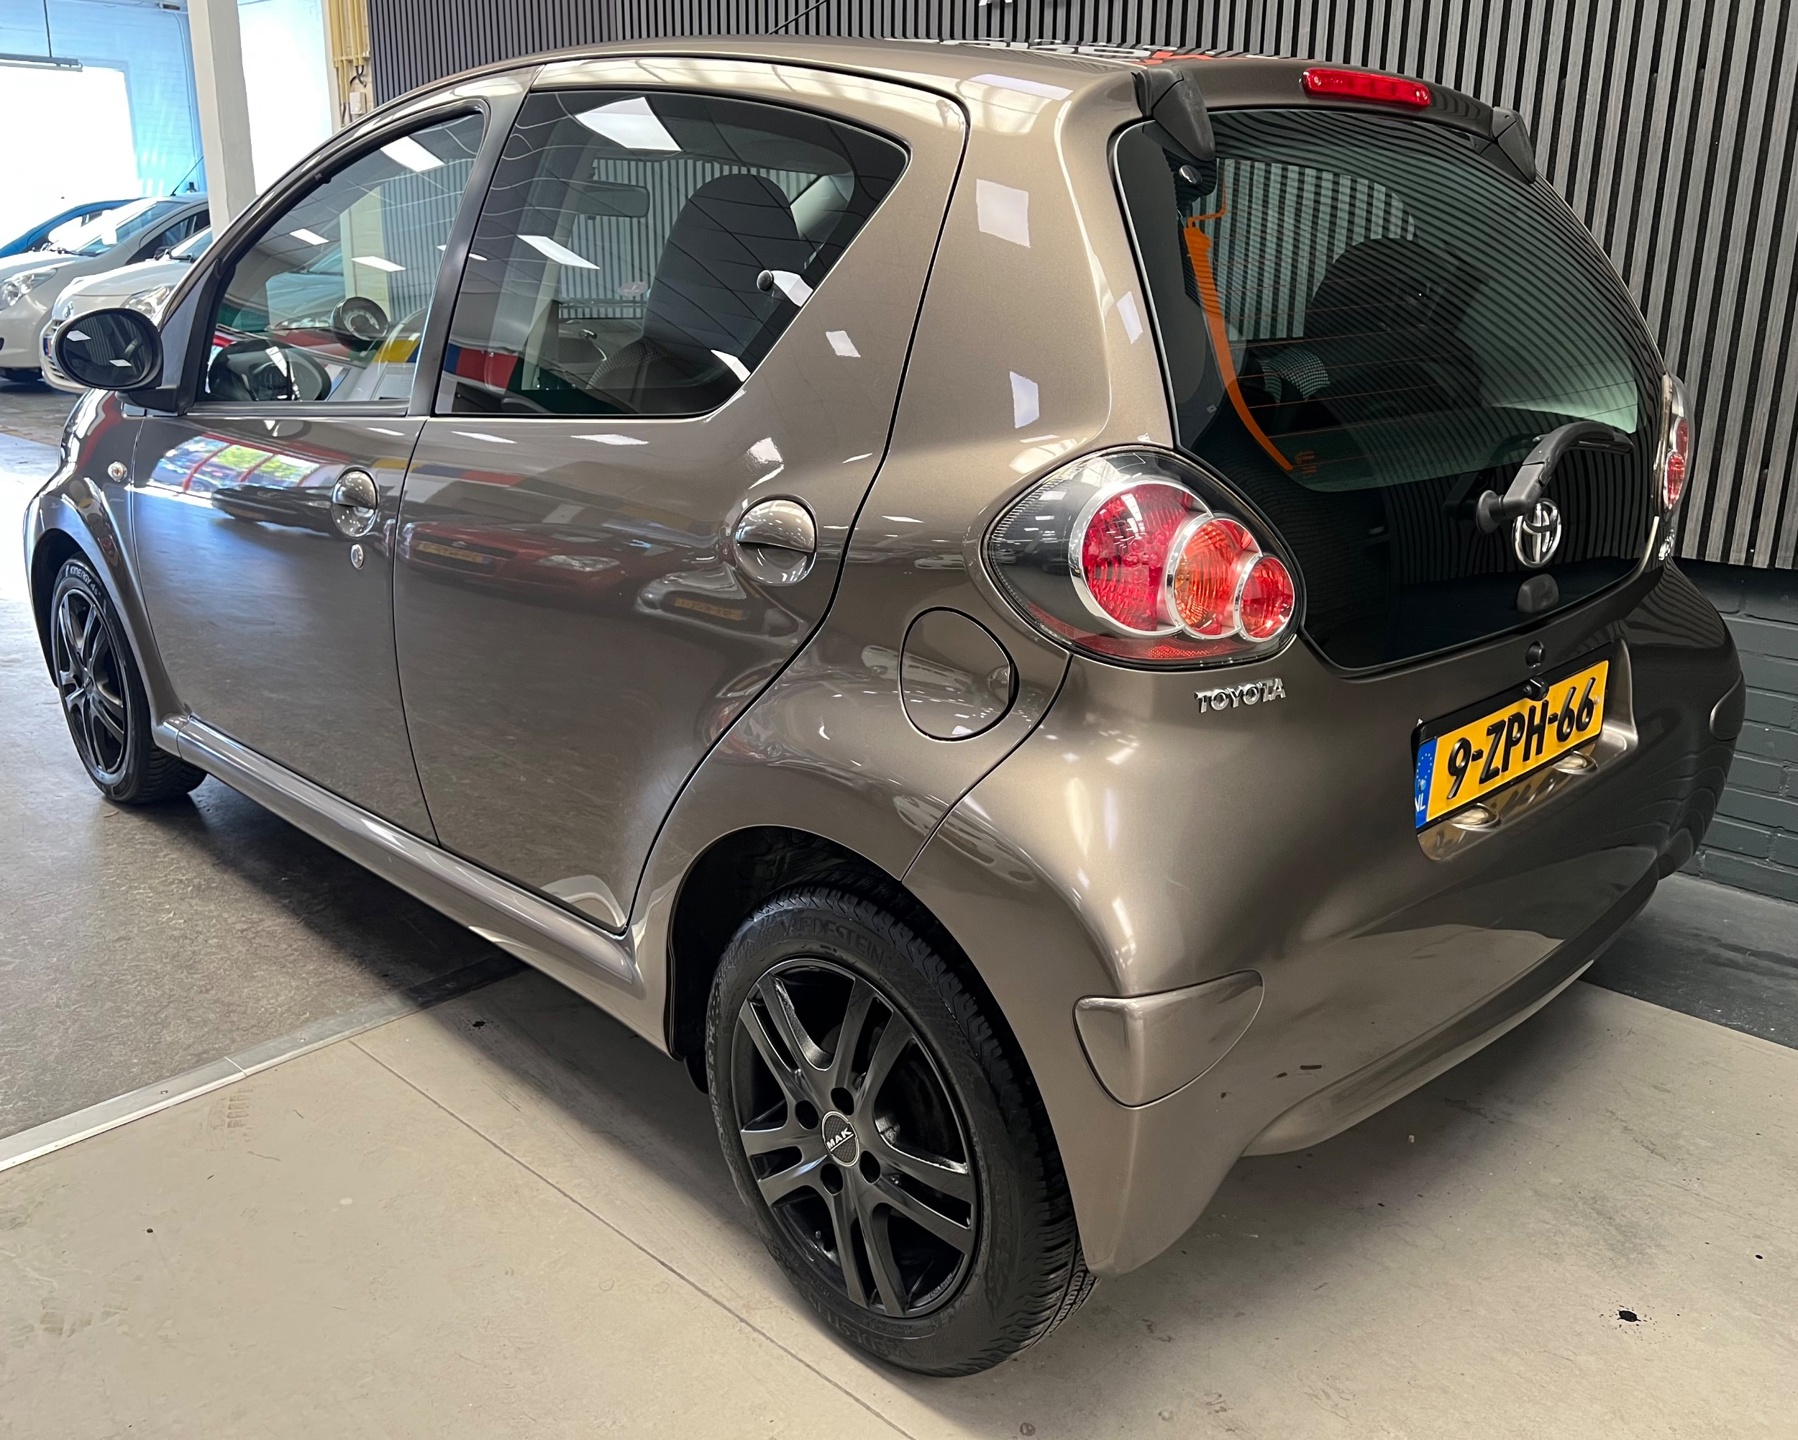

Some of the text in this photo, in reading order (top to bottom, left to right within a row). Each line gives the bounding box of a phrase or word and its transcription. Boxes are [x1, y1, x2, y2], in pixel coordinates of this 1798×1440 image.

[1194, 678, 1286, 714] TOYOTA
[1446, 676, 1597, 801] 9-ZPH-66
[826, 1127, 853, 1150] MAK
